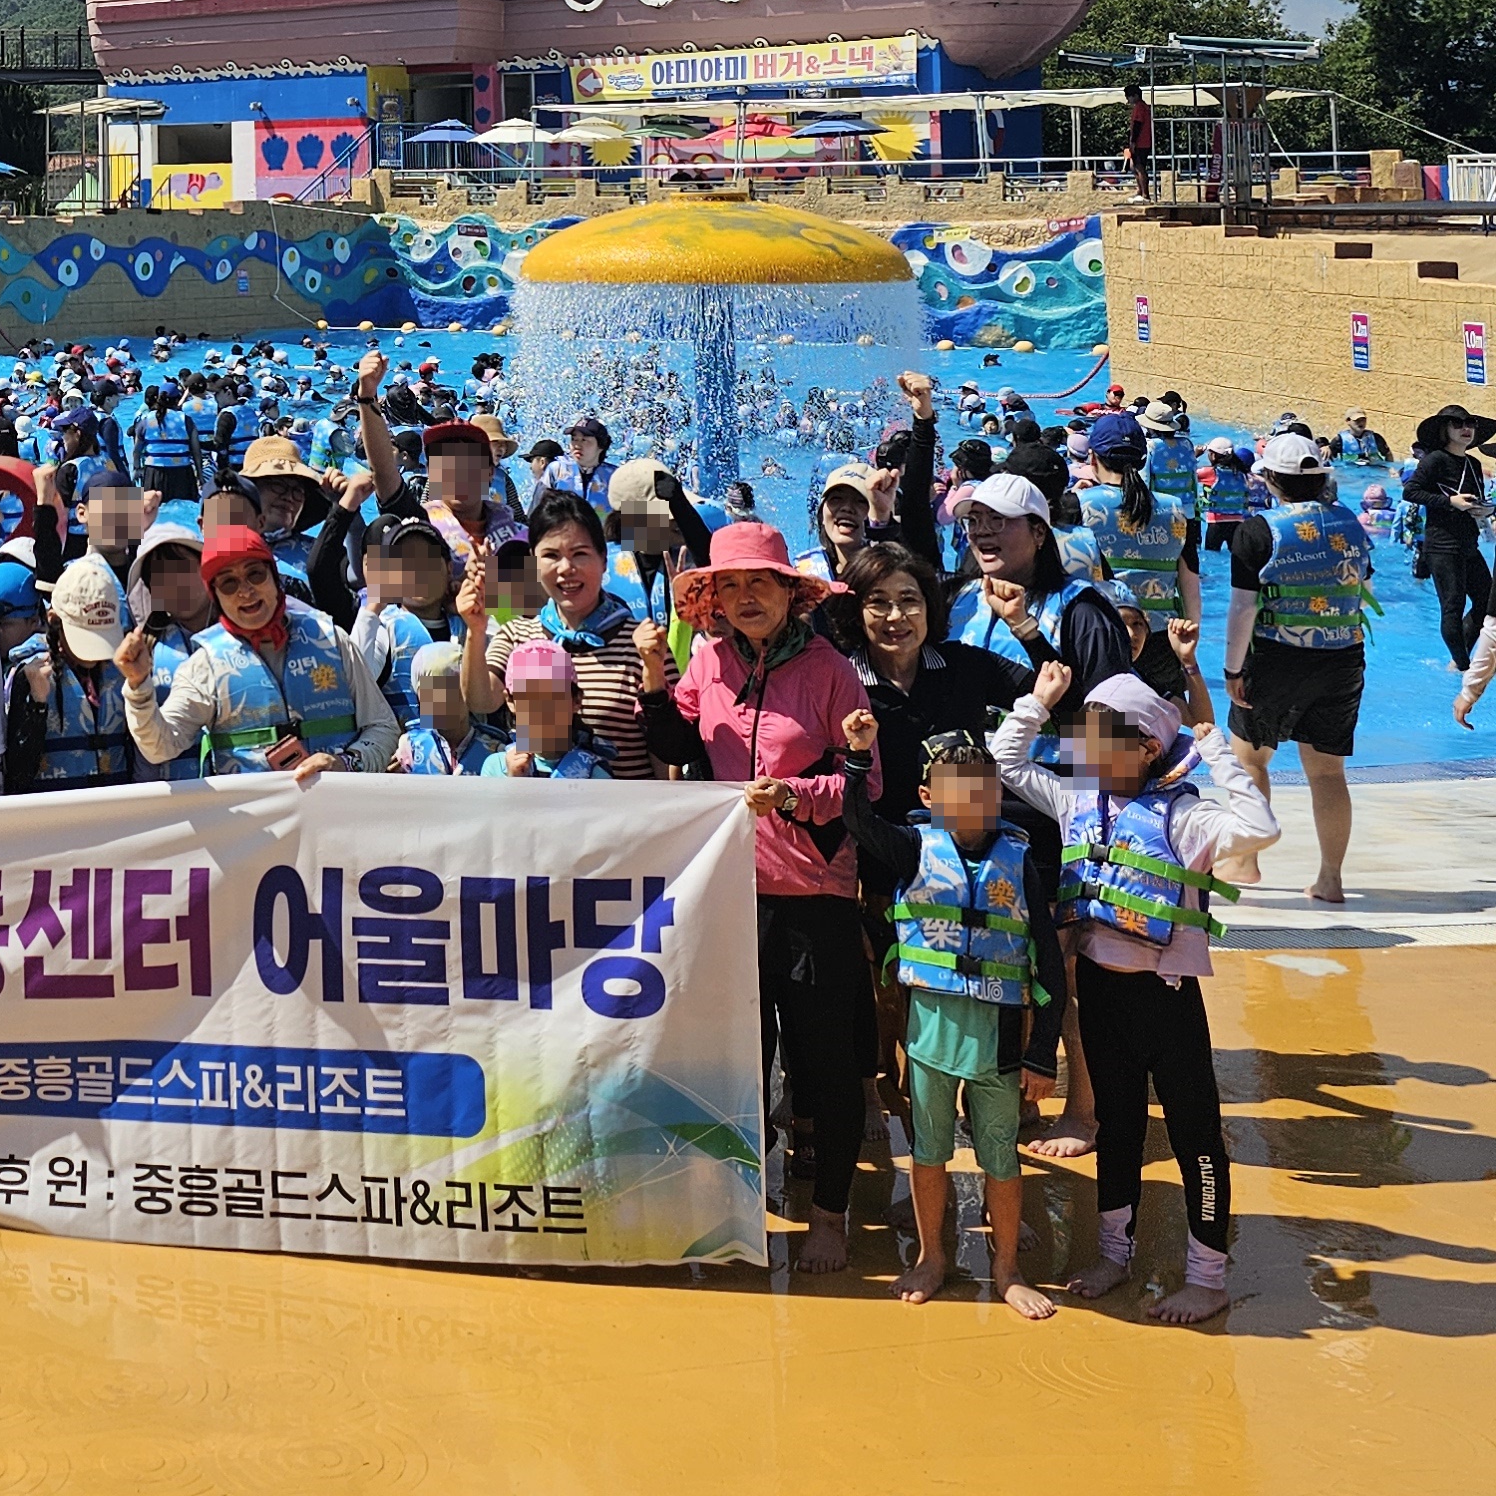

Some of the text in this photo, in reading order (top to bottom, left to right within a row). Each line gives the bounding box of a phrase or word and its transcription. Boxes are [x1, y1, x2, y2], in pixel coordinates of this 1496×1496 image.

[651, 45, 874, 86] 야미야미 버거&스낵
[288, 656, 318, 677] 워터
[253, 864, 674, 1019] 어울마당
[46, 1155, 90, 1210] 원
[132, 1163, 587, 1235] 중흥골드스파&리조트
[1197, 1155, 1216, 1221] CALIFORNIA
